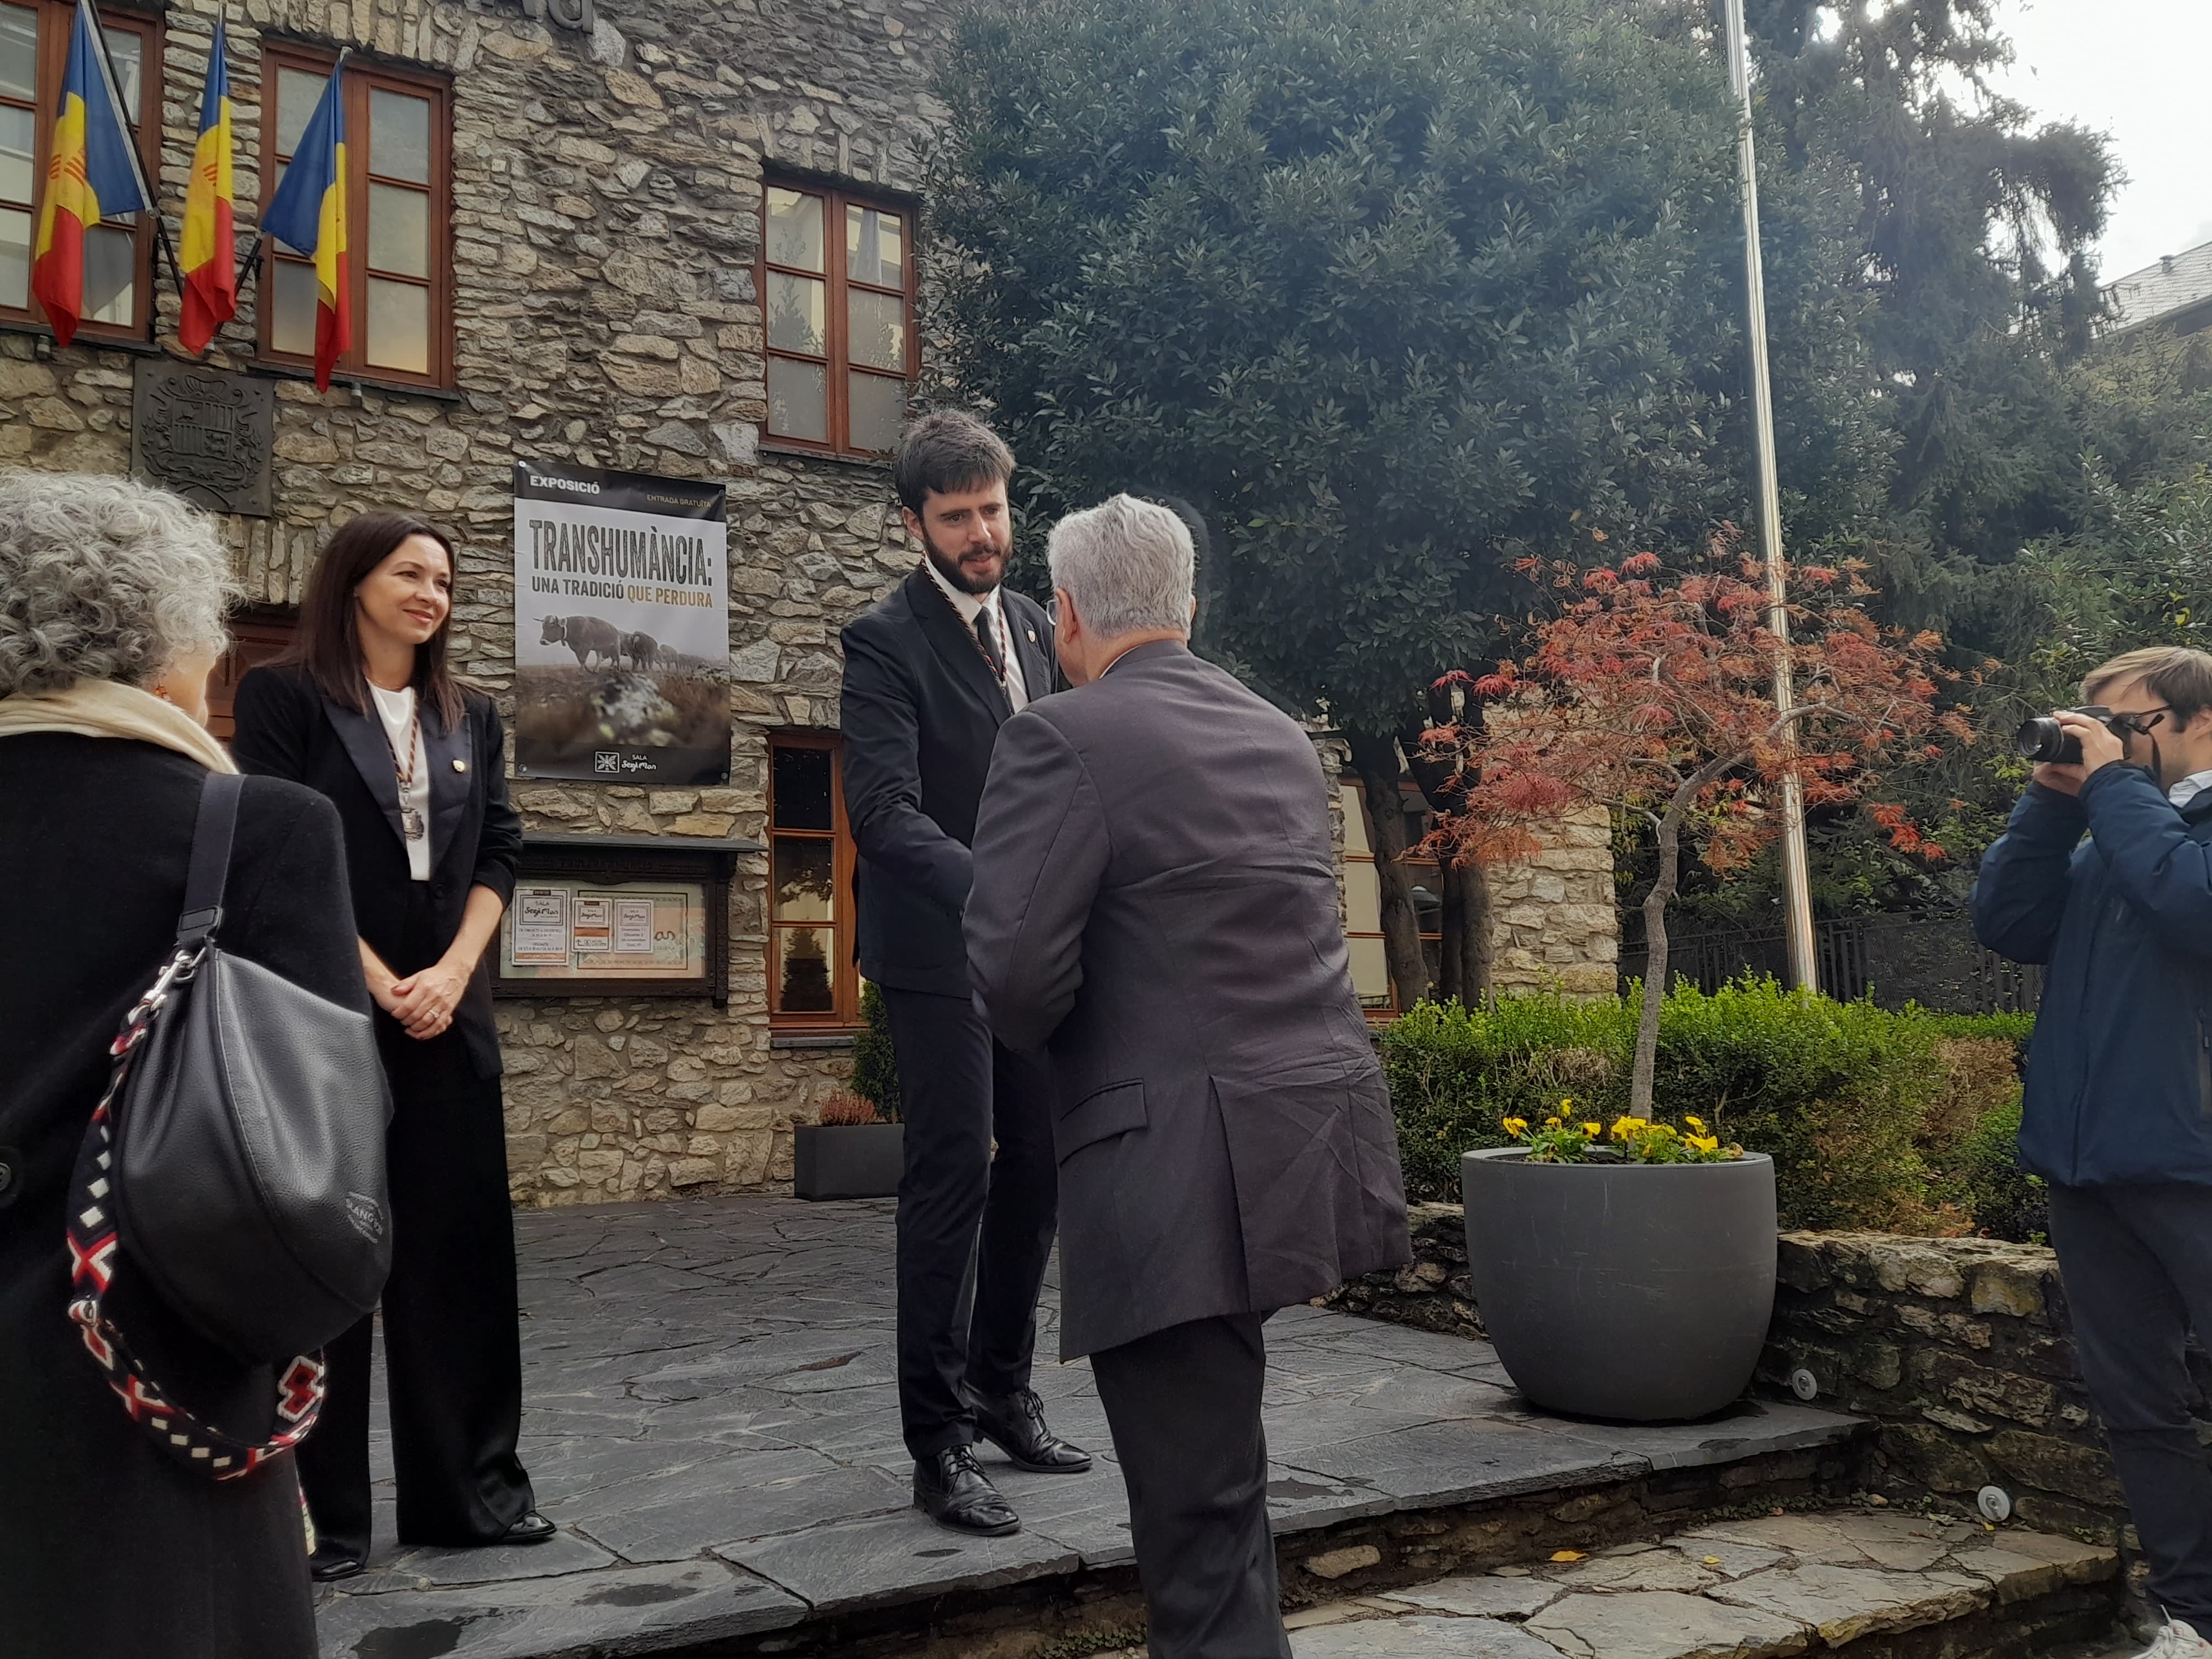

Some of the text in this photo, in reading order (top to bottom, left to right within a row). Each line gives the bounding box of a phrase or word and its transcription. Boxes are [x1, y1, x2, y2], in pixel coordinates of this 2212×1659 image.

[530, 475, 600, 495] EXPOSICIÓ
[646, 494, 679, 505] ENTRADA
[529, 519, 712, 587] TRANSHUMÀNCIA:
[532, 576, 713, 608] UNA TRADICIÓ QUE PERDURA
